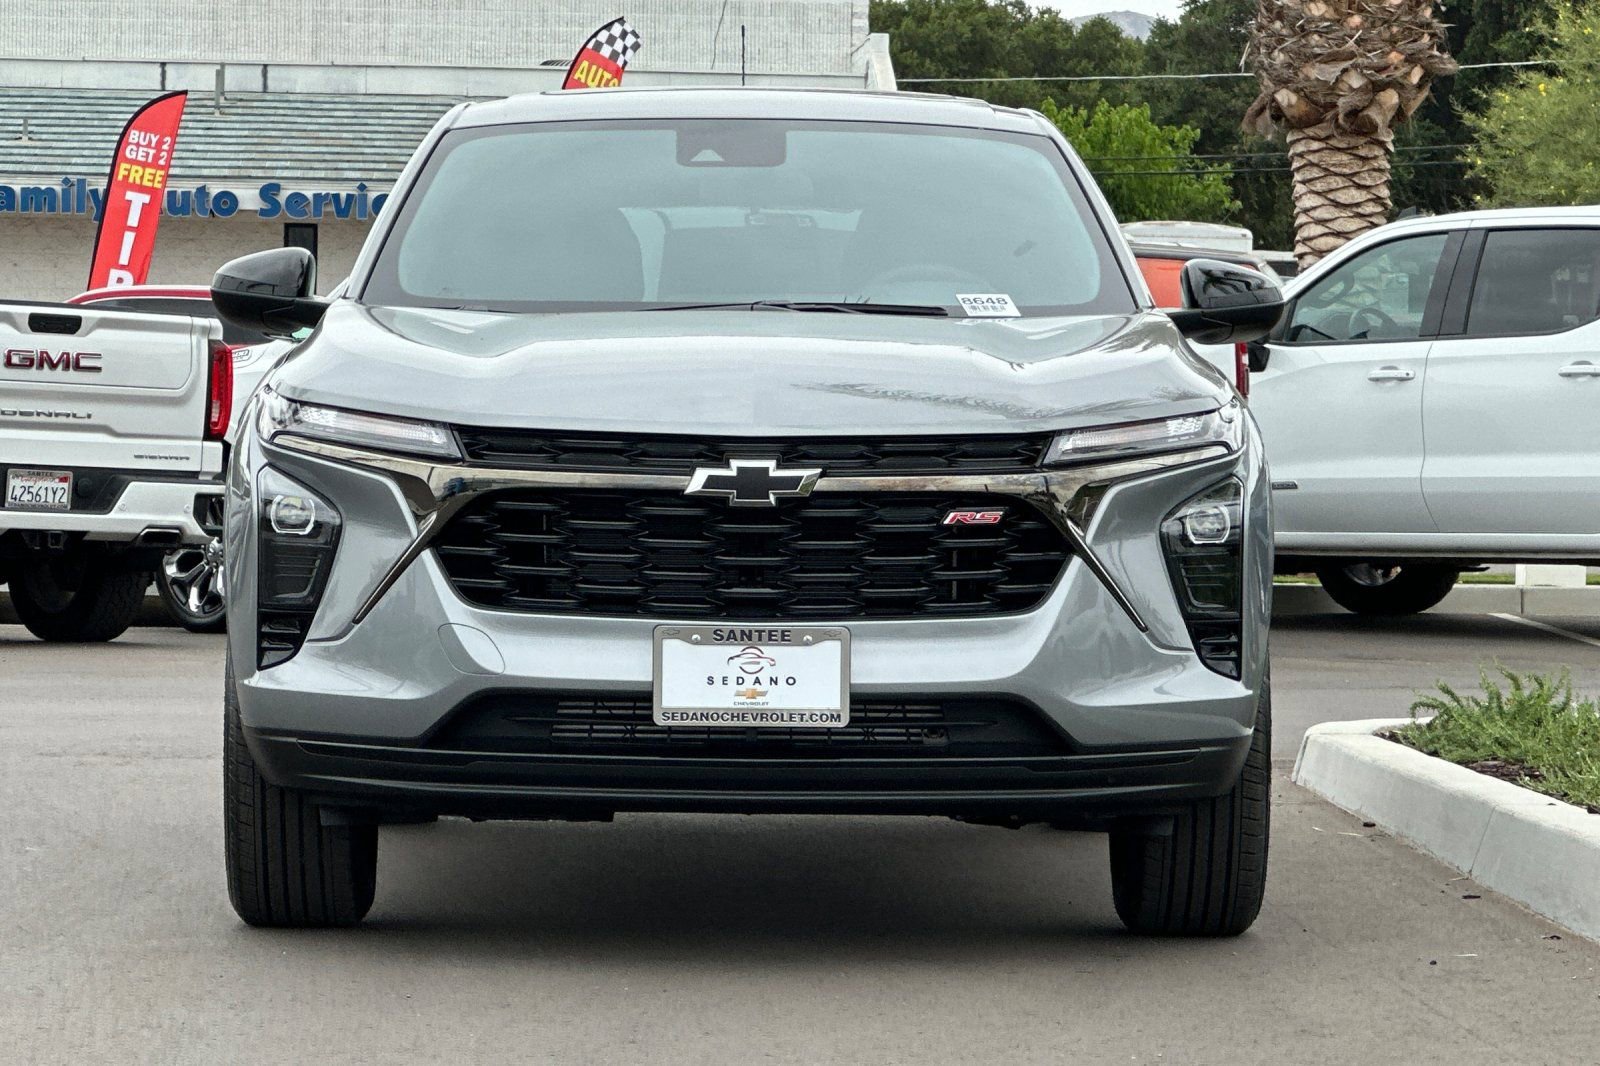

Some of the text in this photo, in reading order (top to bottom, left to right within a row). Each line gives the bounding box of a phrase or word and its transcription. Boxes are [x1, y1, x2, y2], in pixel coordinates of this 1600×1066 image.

[129, 130, 172, 151] BUY 2
[125, 144, 168, 166] GET 2
[117, 162, 166, 189] FREE
[158, 182, 239, 217] uto
[4, 348, 103, 372] GMC
[0, 409, 92, 419] DENALI
[11, 485, 66, 504] 42561Y2
[943, 511, 1004, 524] RS
[712, 628, 792, 643] SANTEE
[706, 676, 797, 686] SEDANO
[661, 711, 842, 723] SEDANOCHEVROLET.COM
